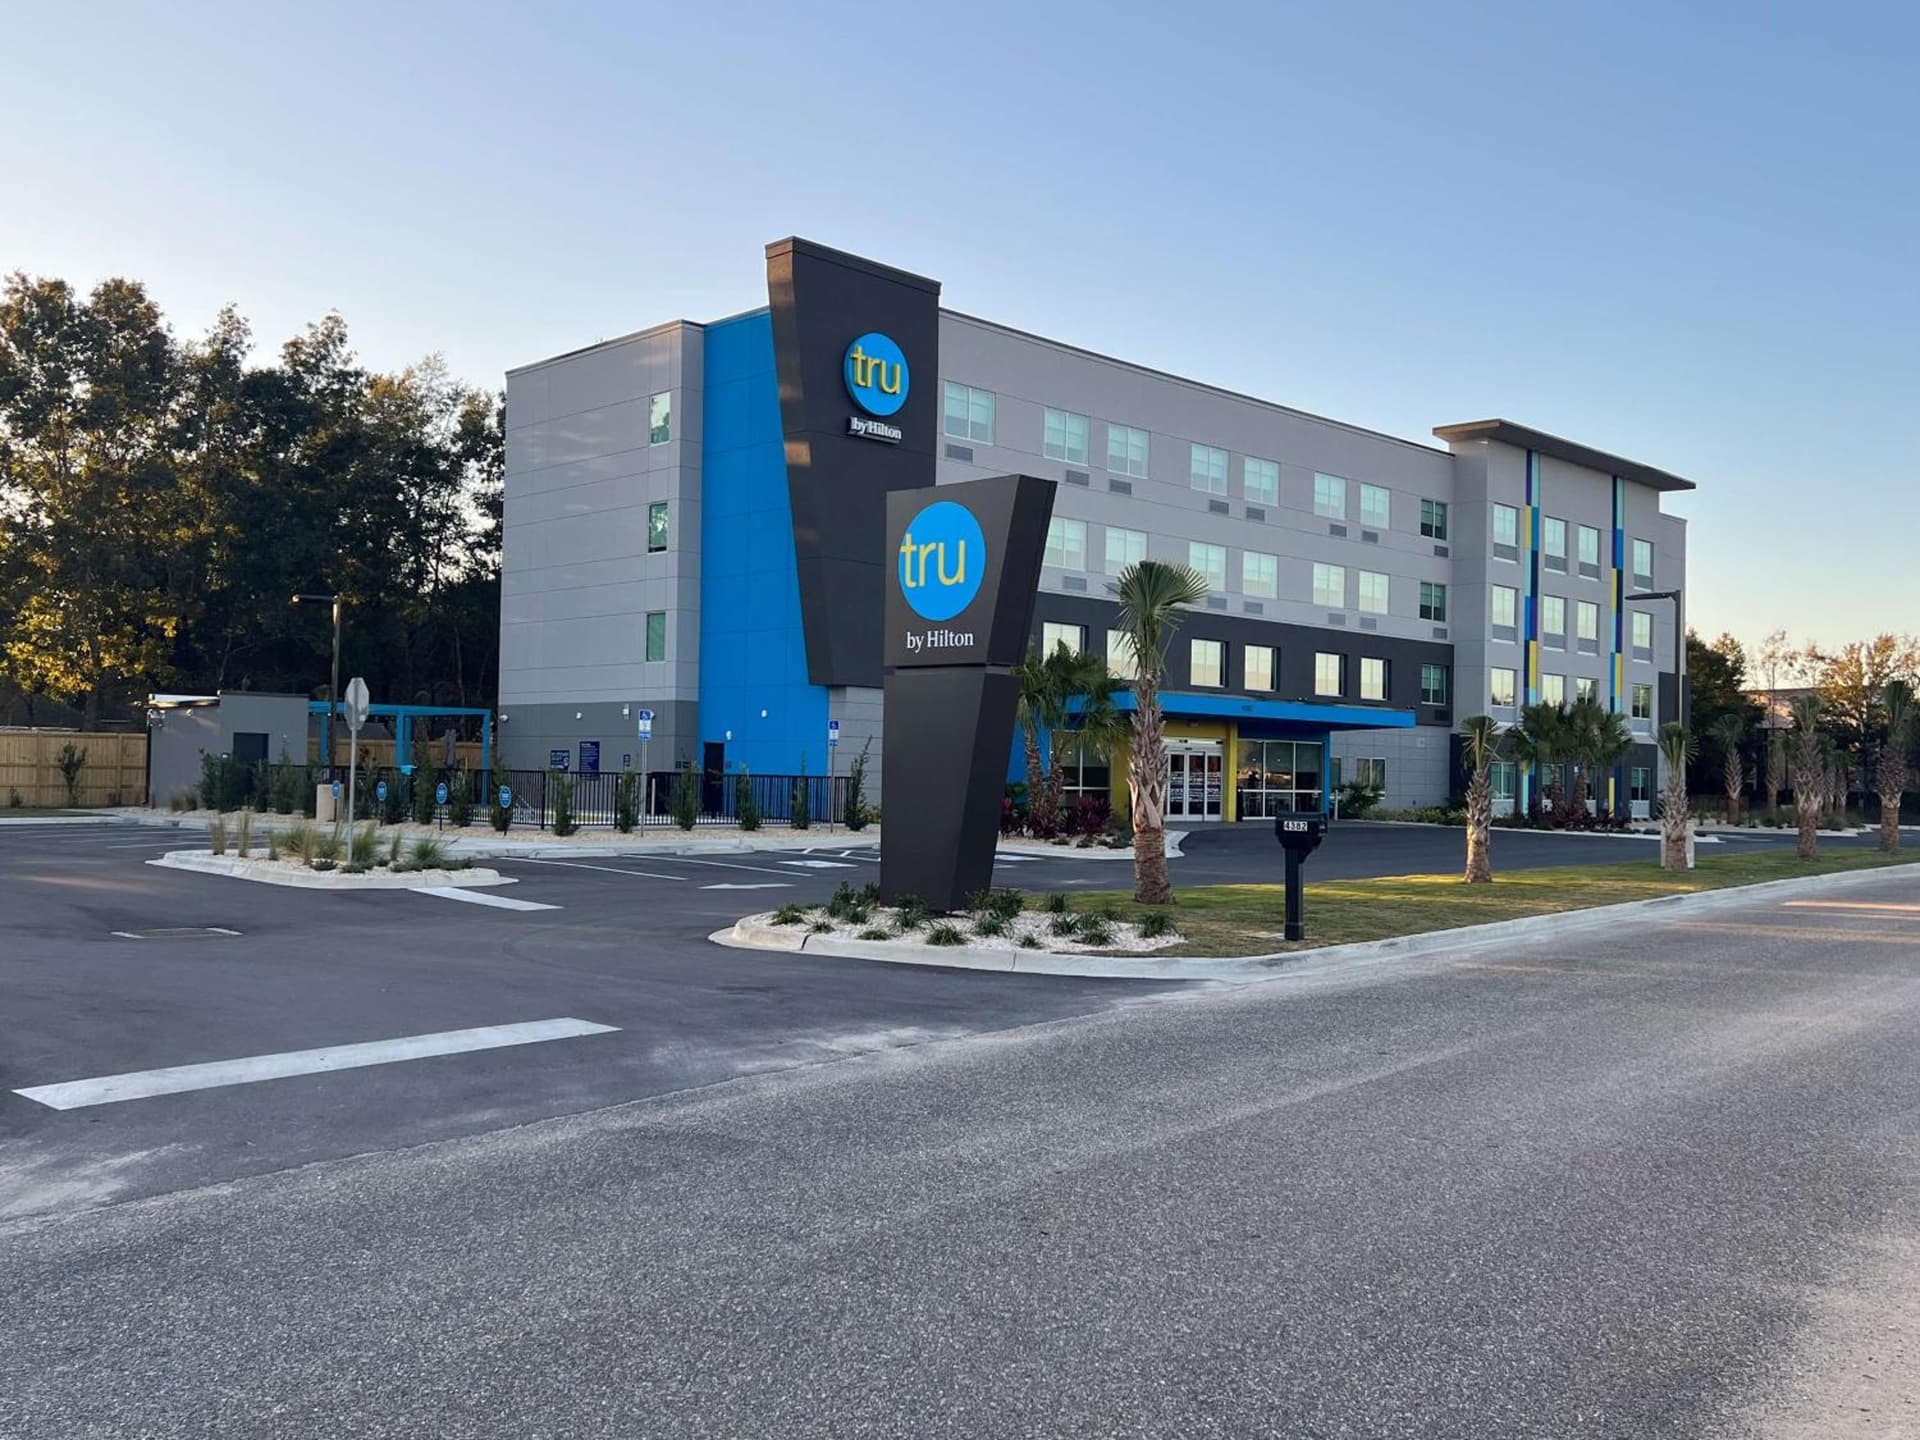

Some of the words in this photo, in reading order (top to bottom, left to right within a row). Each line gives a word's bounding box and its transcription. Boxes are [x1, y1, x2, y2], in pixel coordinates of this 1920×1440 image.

[852, 344, 901, 394] tru
[850, 416, 867, 434] by
[867, 421, 902, 439] Hilton
[900, 533, 966, 588] tru
[906, 631, 924, 654] by
[927, 629, 974, 648] Hilton
